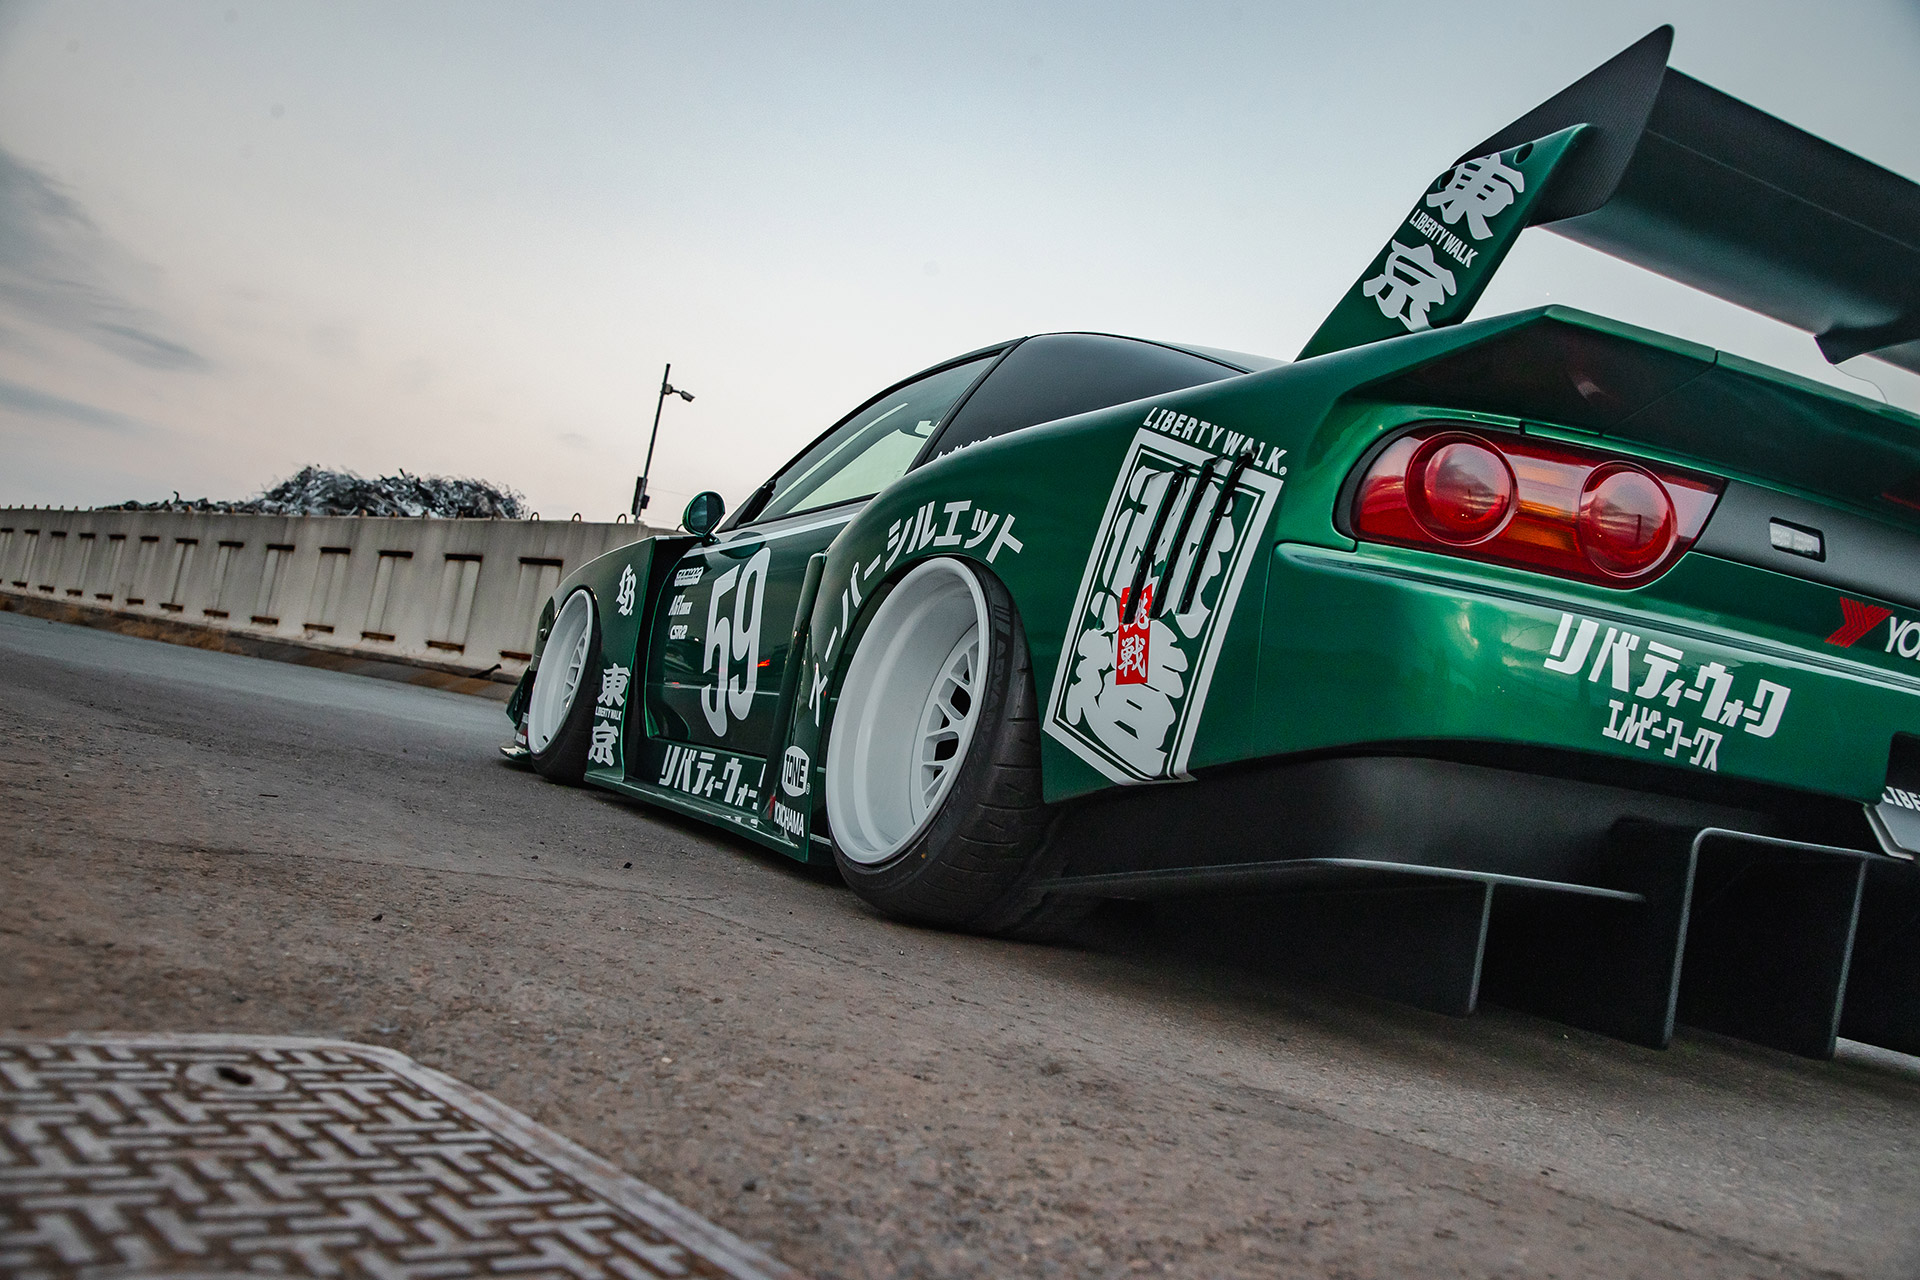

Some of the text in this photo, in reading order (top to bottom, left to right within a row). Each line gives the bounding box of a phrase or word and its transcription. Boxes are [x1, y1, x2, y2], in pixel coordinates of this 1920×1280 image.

[1409, 208, 1479, 269] LIBERTY WALK
[1143, 406, 1225, 449] LIBERTY
[701, 547, 771, 737] 59
[1544, 613, 1791, 738] リバティーウォーク
